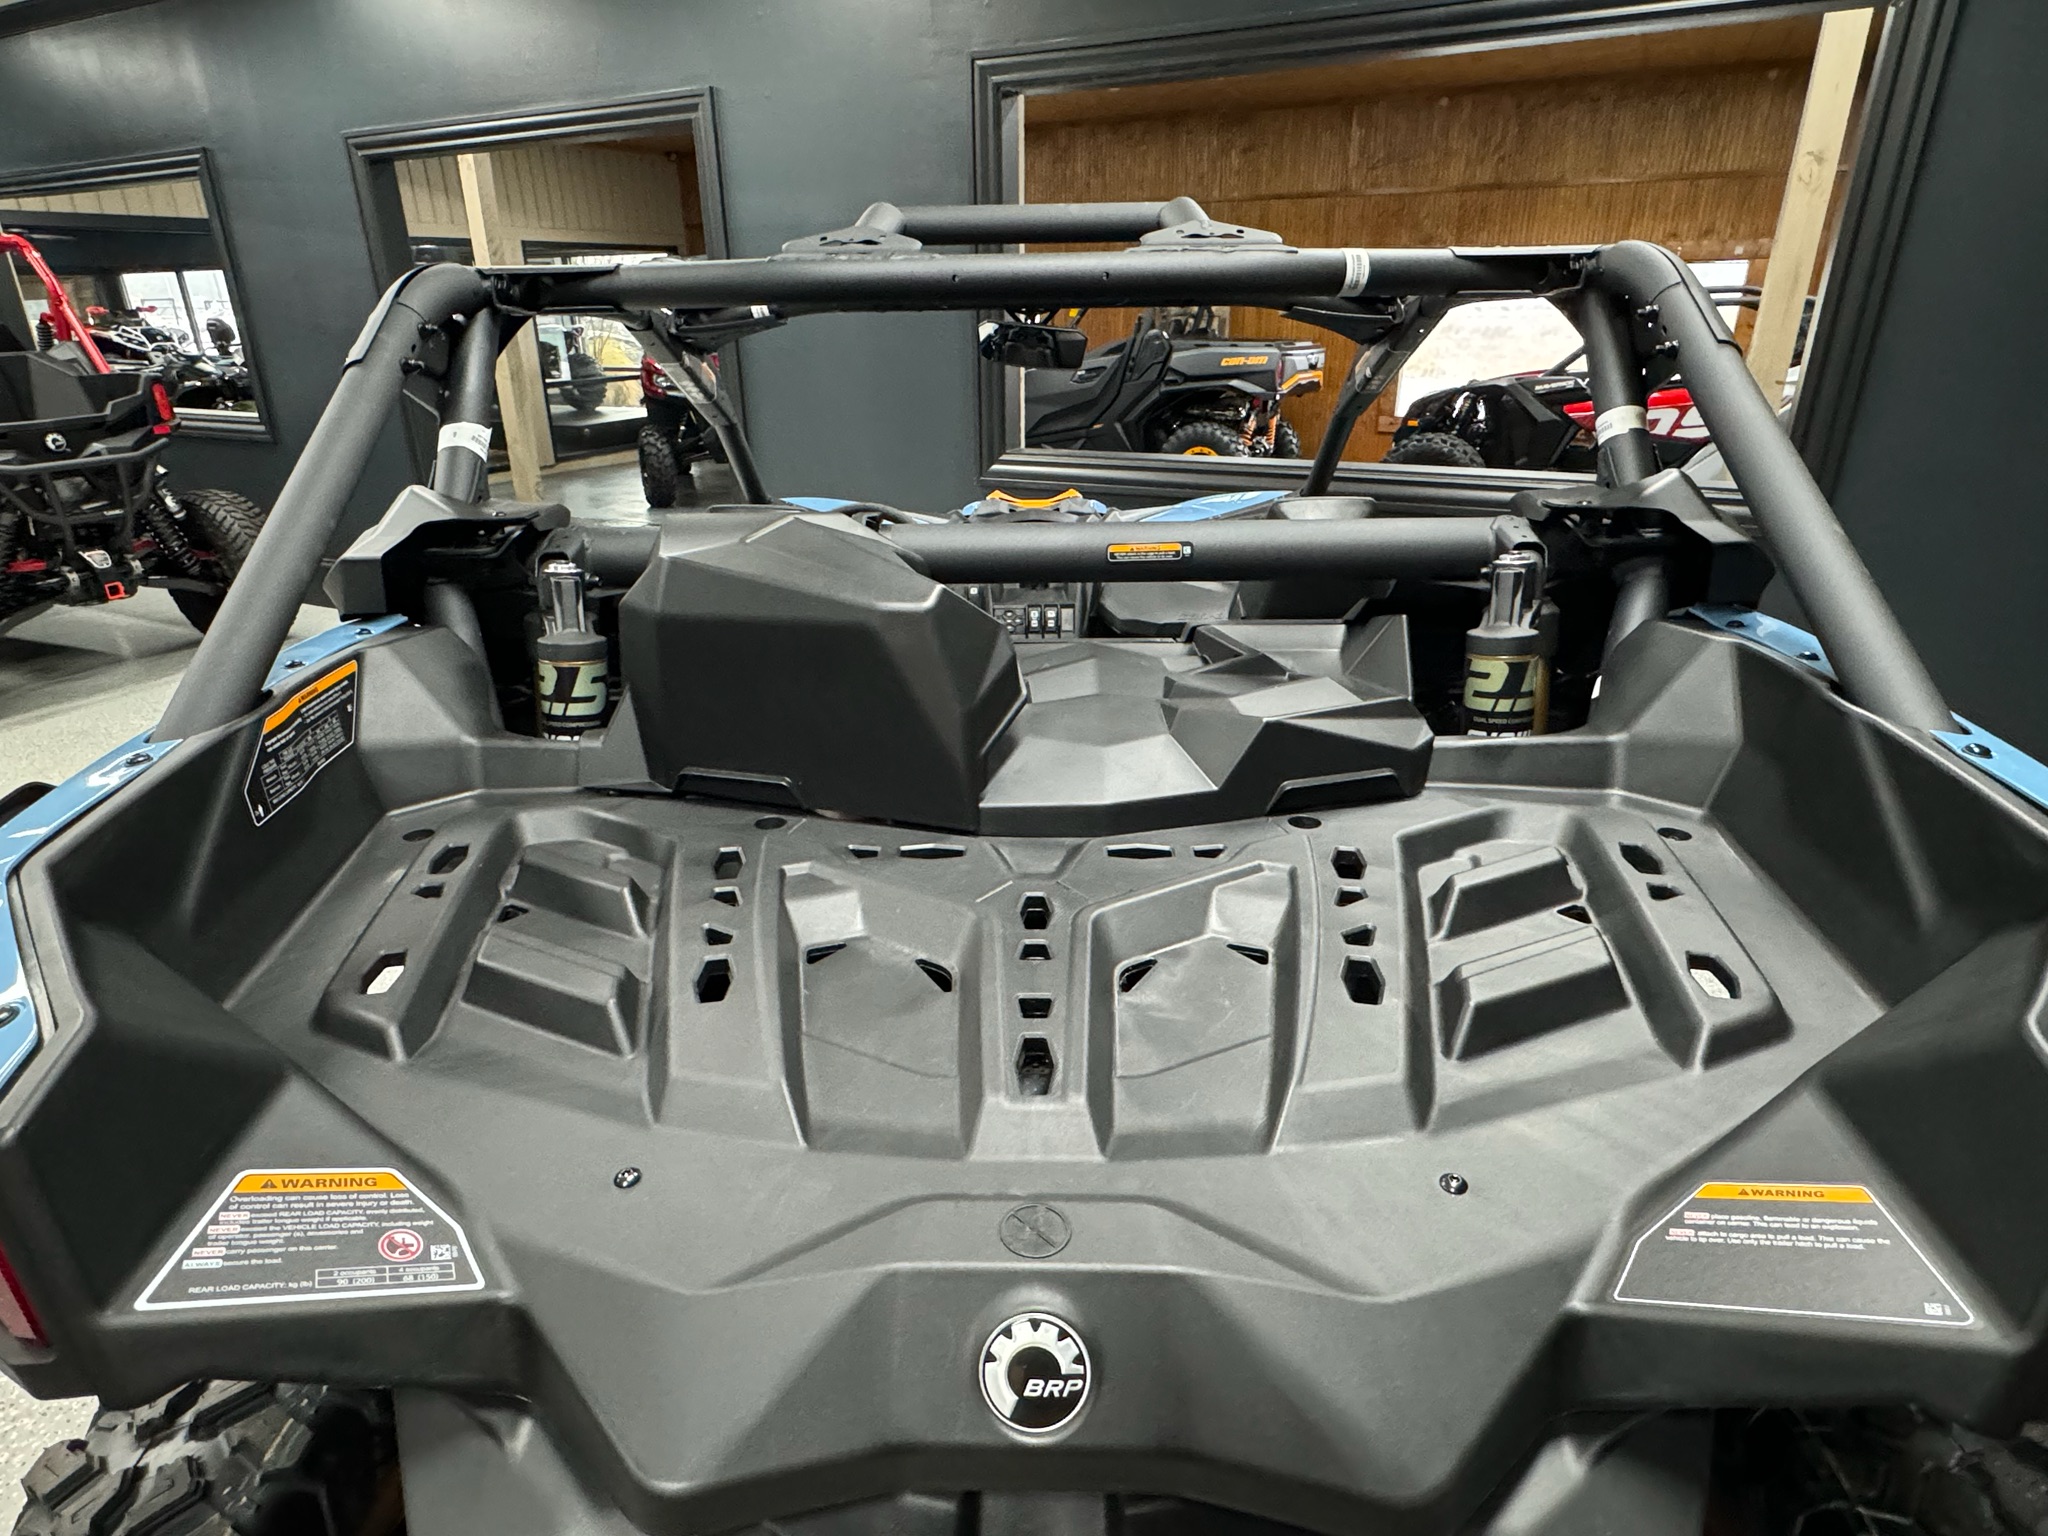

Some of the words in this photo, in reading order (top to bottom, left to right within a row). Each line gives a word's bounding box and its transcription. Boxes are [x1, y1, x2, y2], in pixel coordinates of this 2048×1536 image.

[281, 1178, 377, 1189] WARNING
[1751, 1188, 1825, 1198] WARNING
[352, 1276, 376, 1285] (200)
[417, 1273, 439, 1281] (150)
[215, 1284, 241, 1292] LOAD
[1023, 1379, 1084, 1398] BRP
